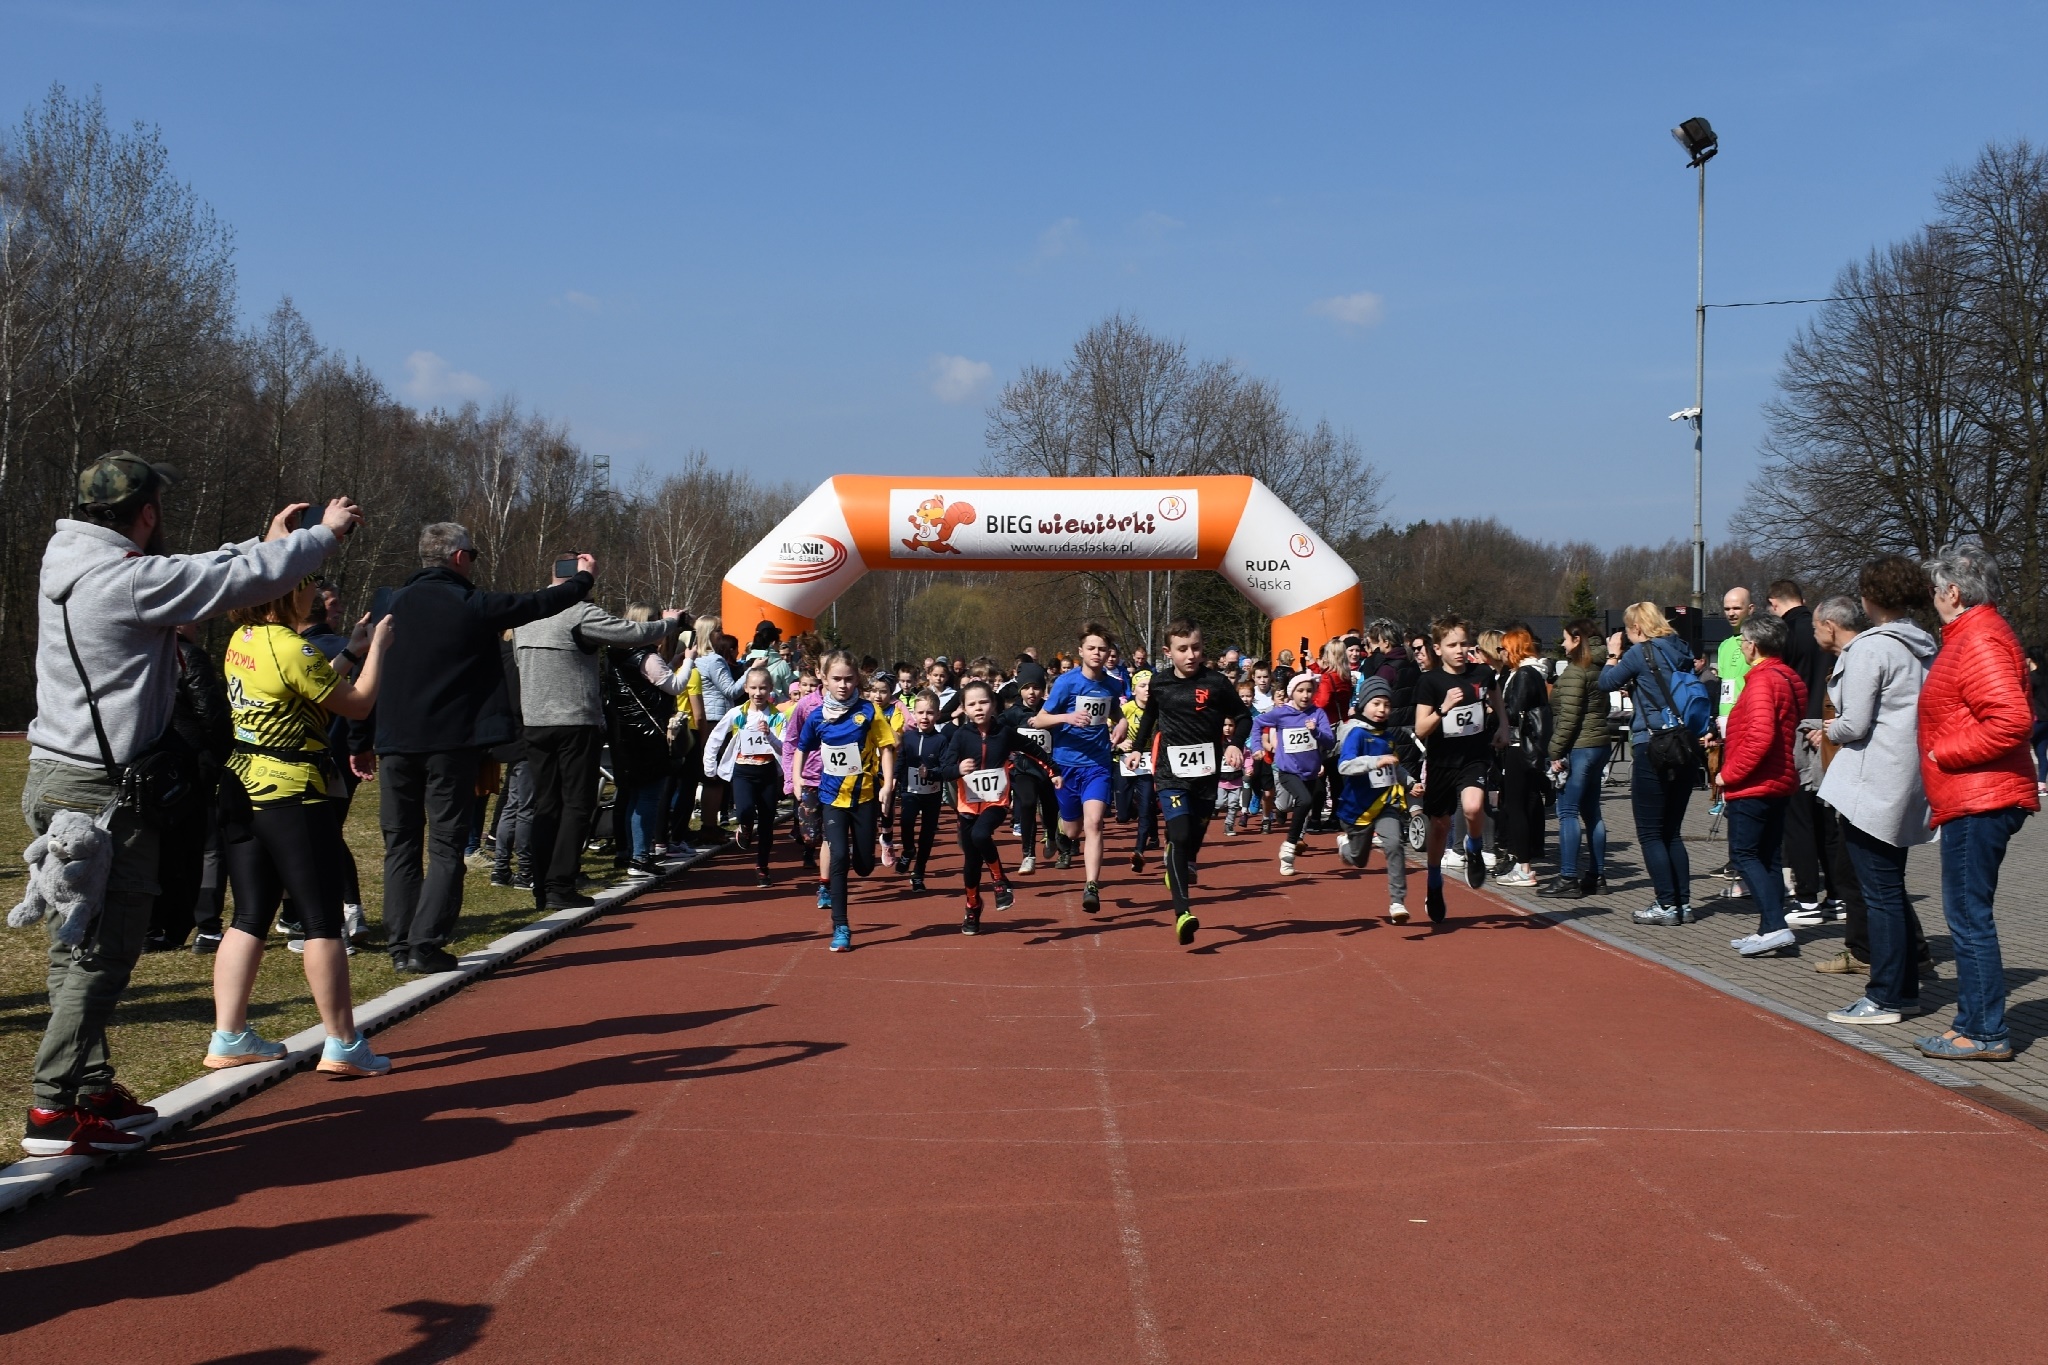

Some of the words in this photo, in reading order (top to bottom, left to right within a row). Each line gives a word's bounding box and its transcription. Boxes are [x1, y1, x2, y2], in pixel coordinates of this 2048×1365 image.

[986, 515, 1032, 534] BIEG
[1038, 511, 1156, 535] wiewiórki
[1010, 541, 1134, 555] www.rudaslaska.pl
[1245, 559, 1291, 572] RUDA
[1247, 575, 1291, 592] Śląska
[226, 648, 257, 672] SYLWIA
[1456, 710, 1474, 727] 62
[1289, 731, 1310, 745] 225
[830, 751, 848, 767] 42
[1178, 750, 1206, 767] 241
[972, 775, 1000, 792] 107
